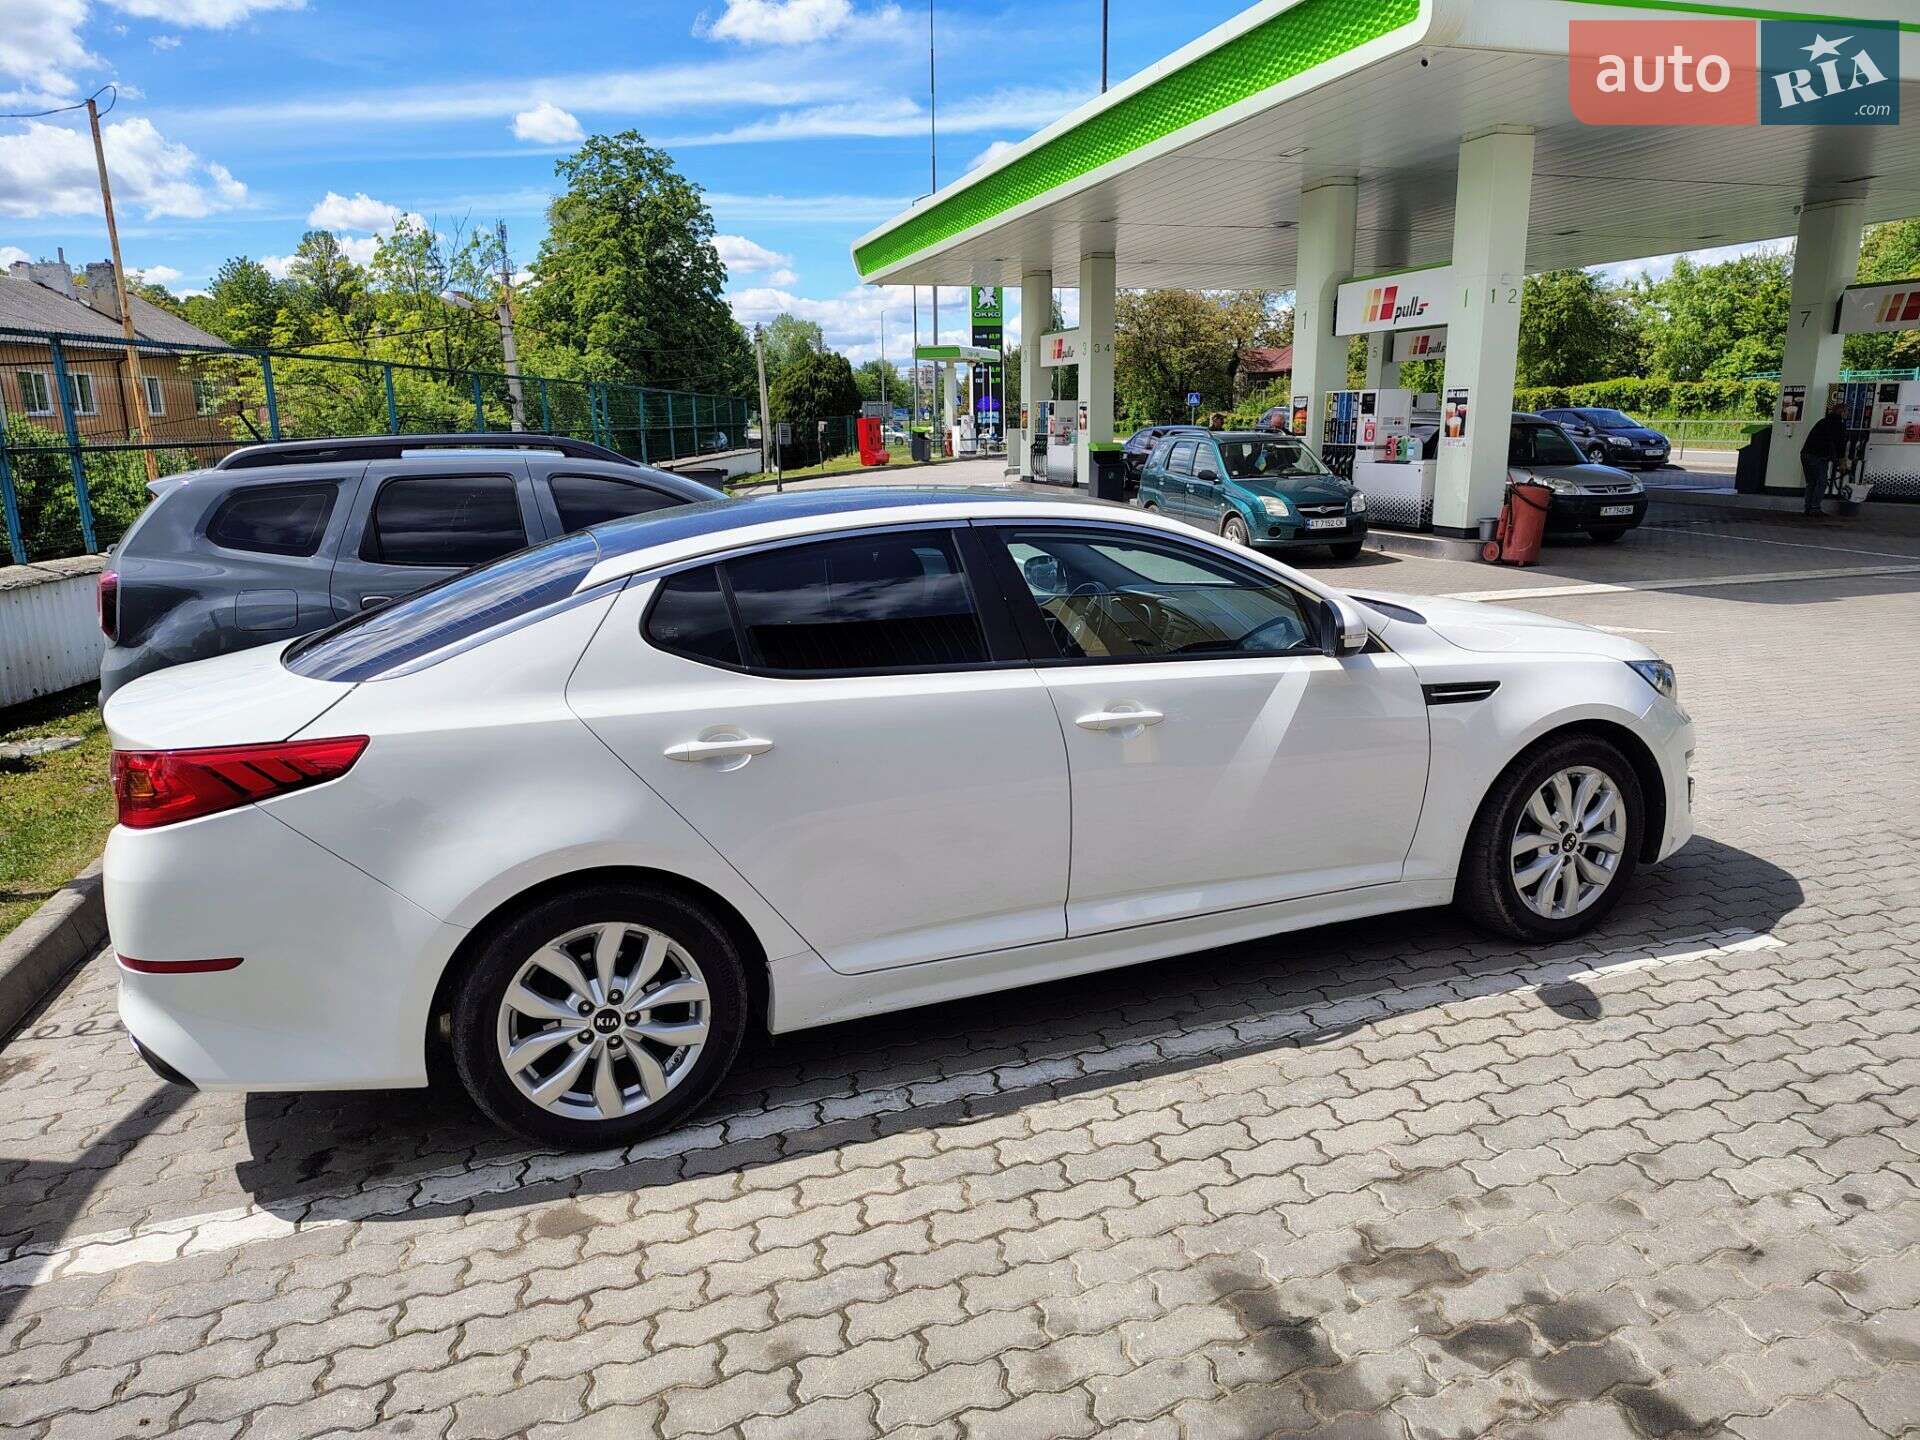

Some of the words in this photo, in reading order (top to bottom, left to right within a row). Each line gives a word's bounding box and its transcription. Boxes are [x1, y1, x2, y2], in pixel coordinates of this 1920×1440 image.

[1491, 288, 1497, 304] 1
[1507, 288, 1518, 304] 2
[1393, 296, 1429, 325] pulls
[1302, 310, 1308, 330] 1
[1800, 310, 1812, 329] 7
[1094, 343, 1101, 354] 3
[1104, 343, 1111, 353] 4
[597, 1017, 618, 1027] KIA
